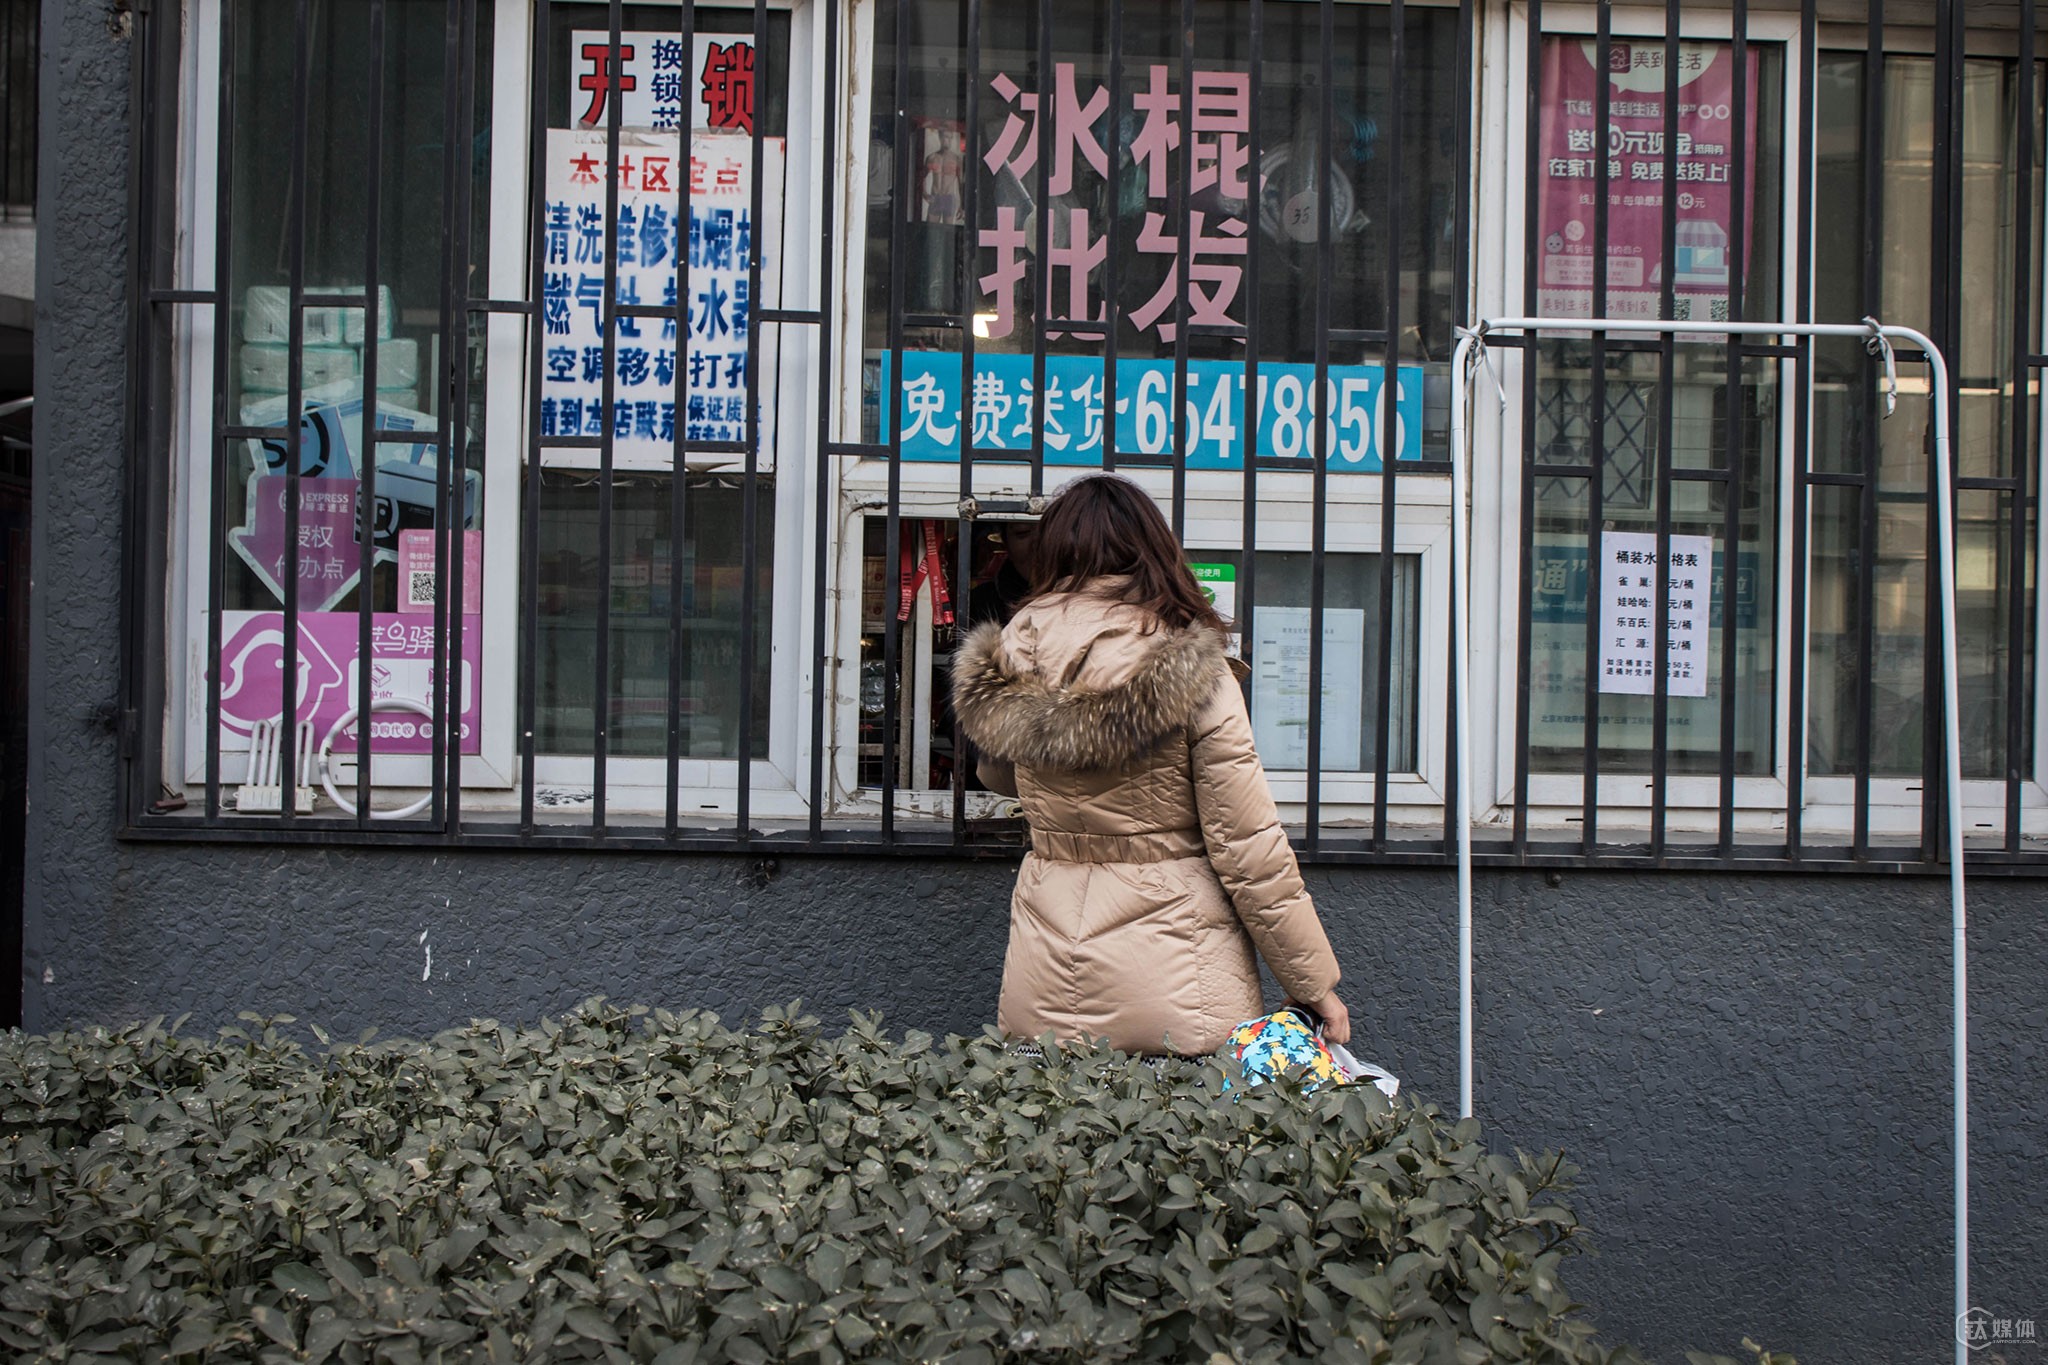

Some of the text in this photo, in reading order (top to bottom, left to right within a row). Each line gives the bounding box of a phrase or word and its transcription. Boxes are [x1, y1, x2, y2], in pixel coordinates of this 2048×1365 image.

[982, 62, 1267, 201] 冰棍
[977, 206, 1252, 344] 批发
[900, 368, 1406, 464] 免费送货 65478856
[305, 492, 349, 504] EXPRESS
[1193, 568, 1222, 578] 迎使用
[1616, 550, 1698, 567] 桶装水格表
[353, 621, 469, 655] 菜鸟驿
